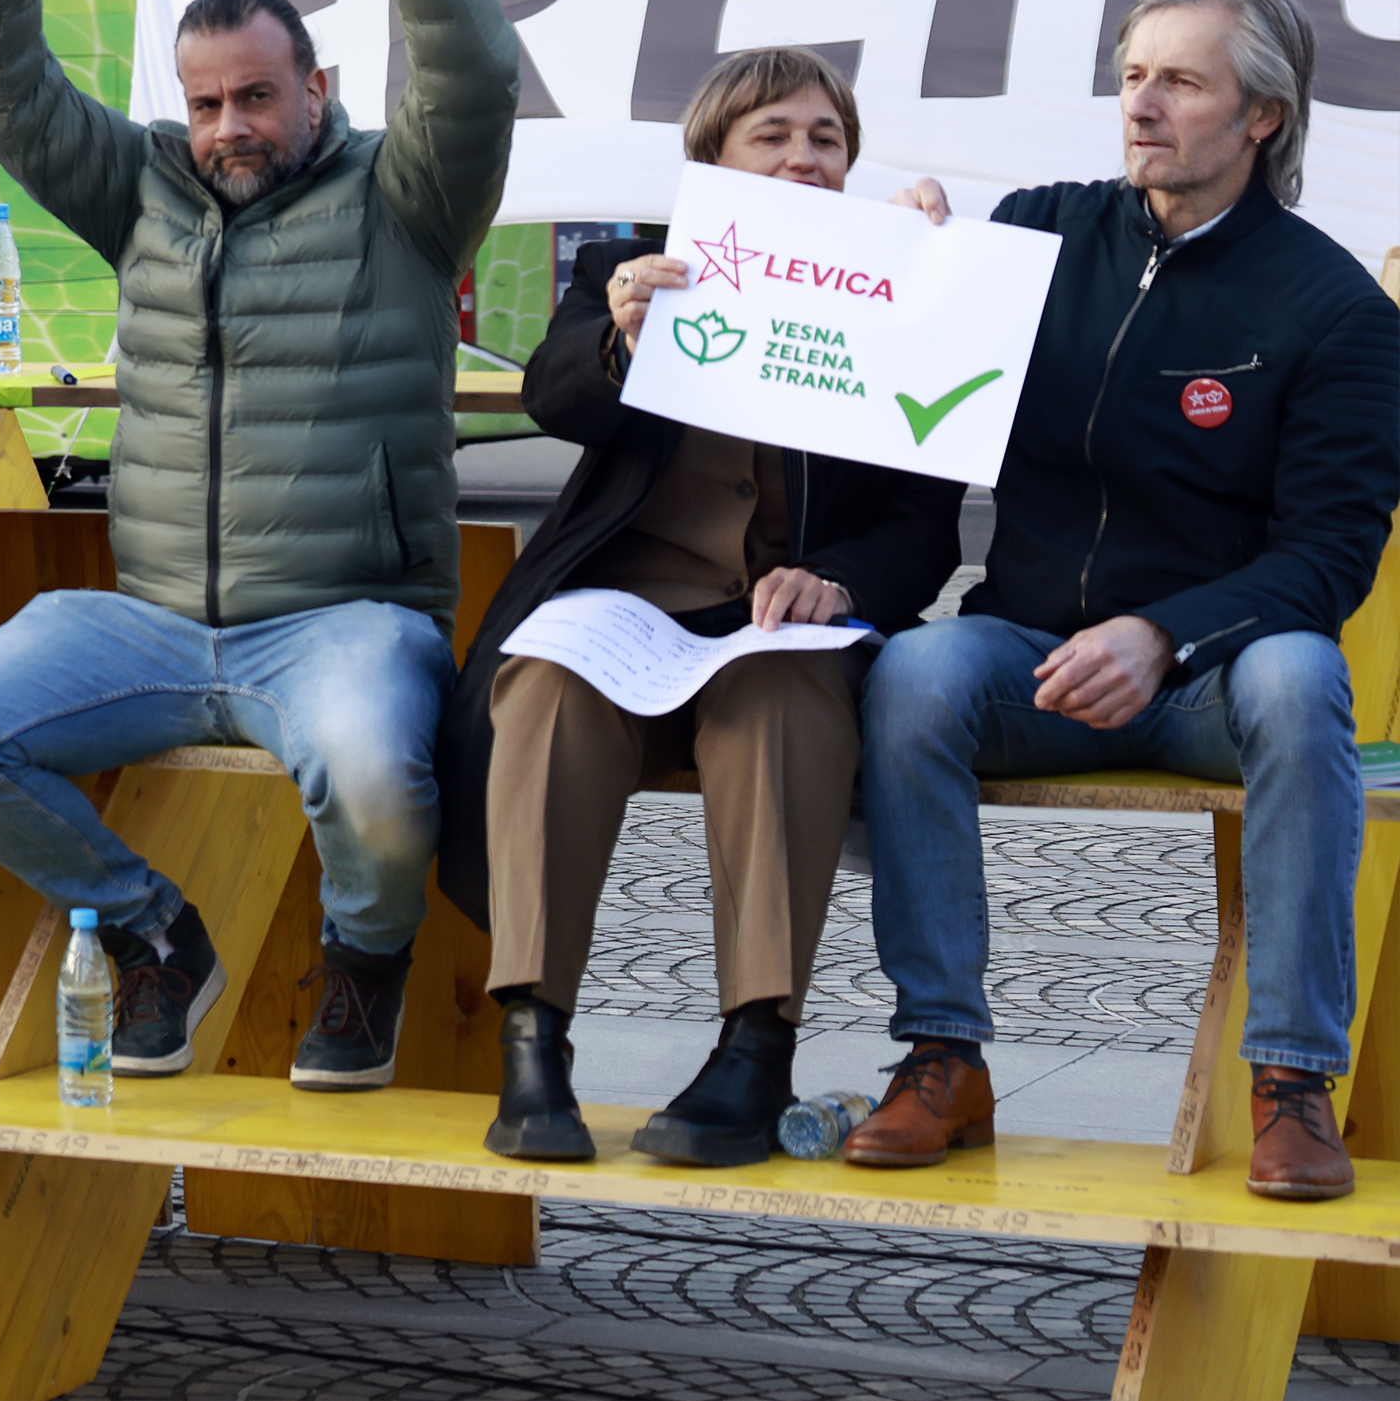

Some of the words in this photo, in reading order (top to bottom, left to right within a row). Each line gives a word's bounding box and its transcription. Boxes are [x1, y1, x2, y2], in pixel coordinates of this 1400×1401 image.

[764, 254, 894, 302] LEVICA
[771, 318, 846, 348] VESNA
[765, 341, 854, 372] ZELENA
[760, 364, 866, 397] STRANKA
